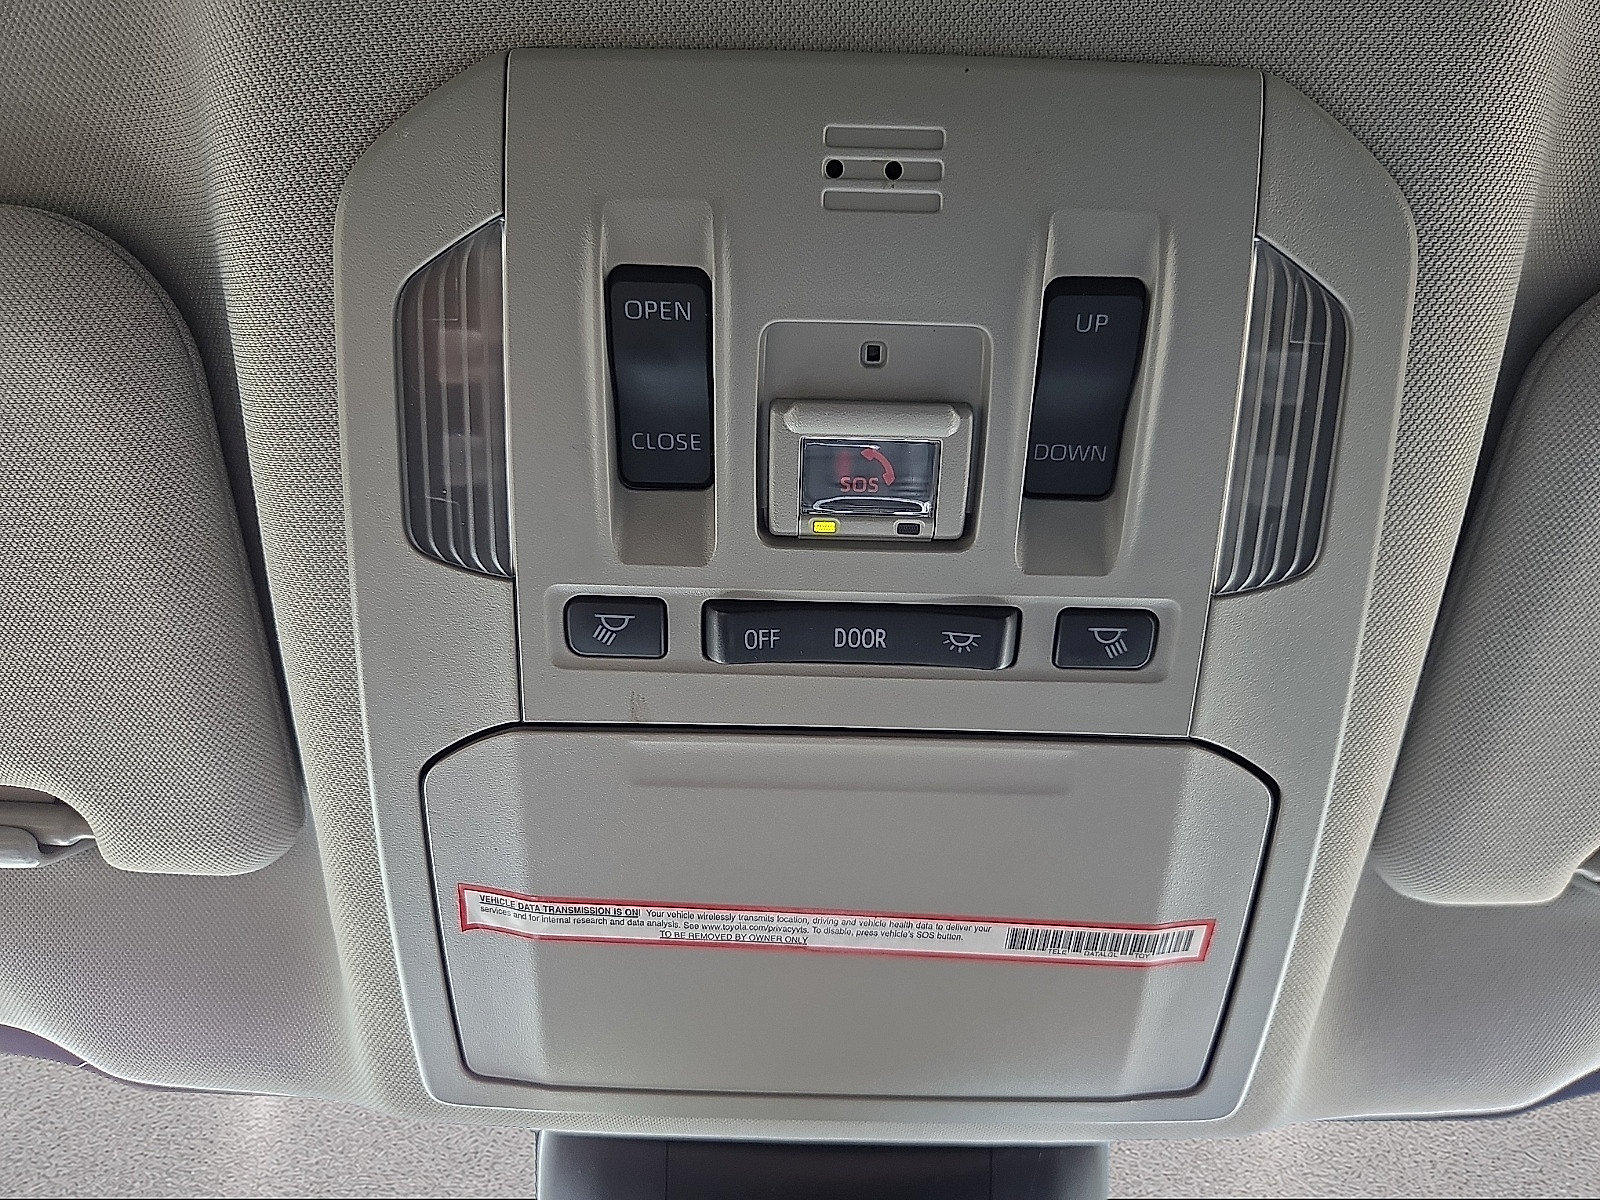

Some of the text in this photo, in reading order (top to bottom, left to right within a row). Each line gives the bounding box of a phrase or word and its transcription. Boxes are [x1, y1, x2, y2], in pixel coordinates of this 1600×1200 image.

[624, 300, 691, 321] OPEN
[1075, 313, 1109, 333] UP
[631, 432, 702, 451] CLOSE
[1034, 443, 1107, 462] DOWN
[839, 476, 879, 493] SOS
[744, 629, 781, 650] OFF
[834, 627, 887, 649] DOOR
[479, 895, 515, 908] VEHICLE
[518, 902, 540, 912] DATA
[543, 905, 611, 916] TRANSMISSION
[646, 909, 665, 919] Your
[667, 910, 695, 920] vehicle
[697, 913, 736, 923] wirelessly
[738, 914, 775, 922] transmits
[777, 915, 810, 925] location,
[812, 916, 839, 926] driving
[841, 918, 857, 926] and
[859, 919, 887, 928] vehicle
[889, 920, 913, 929] health
[916, 922, 933, 930] data
[935, 923, 943, 931] to
[946, 923, 972, 932] deliver
[974, 926, 992, 934] your
[480, 906, 511, 916] services
[513, 911, 527, 920] and
[528, 913, 540, 922] for
[541, 914, 571, 924] internal
[573, 916, 607, 925] research
[610, 918, 625, 926] and
[647, 920, 681, 929] analysis.
[683, 922, 699, 930] See
[812, 926, 822, 934] To
[823, 927, 854, 937] disable,
[856, 930, 878, 938] press
[880, 929, 914, 938] vehicle's
[916, 931, 935, 939] SOS
[937, 932, 963, 941] button.
[660, 930, 672, 938] TO
[688, 932, 732, 941] REMOVED
[735, 933, 747, 941] BY
[749, 934, 782, 943] OWNER
[785, 935, 808, 945] ONLY
